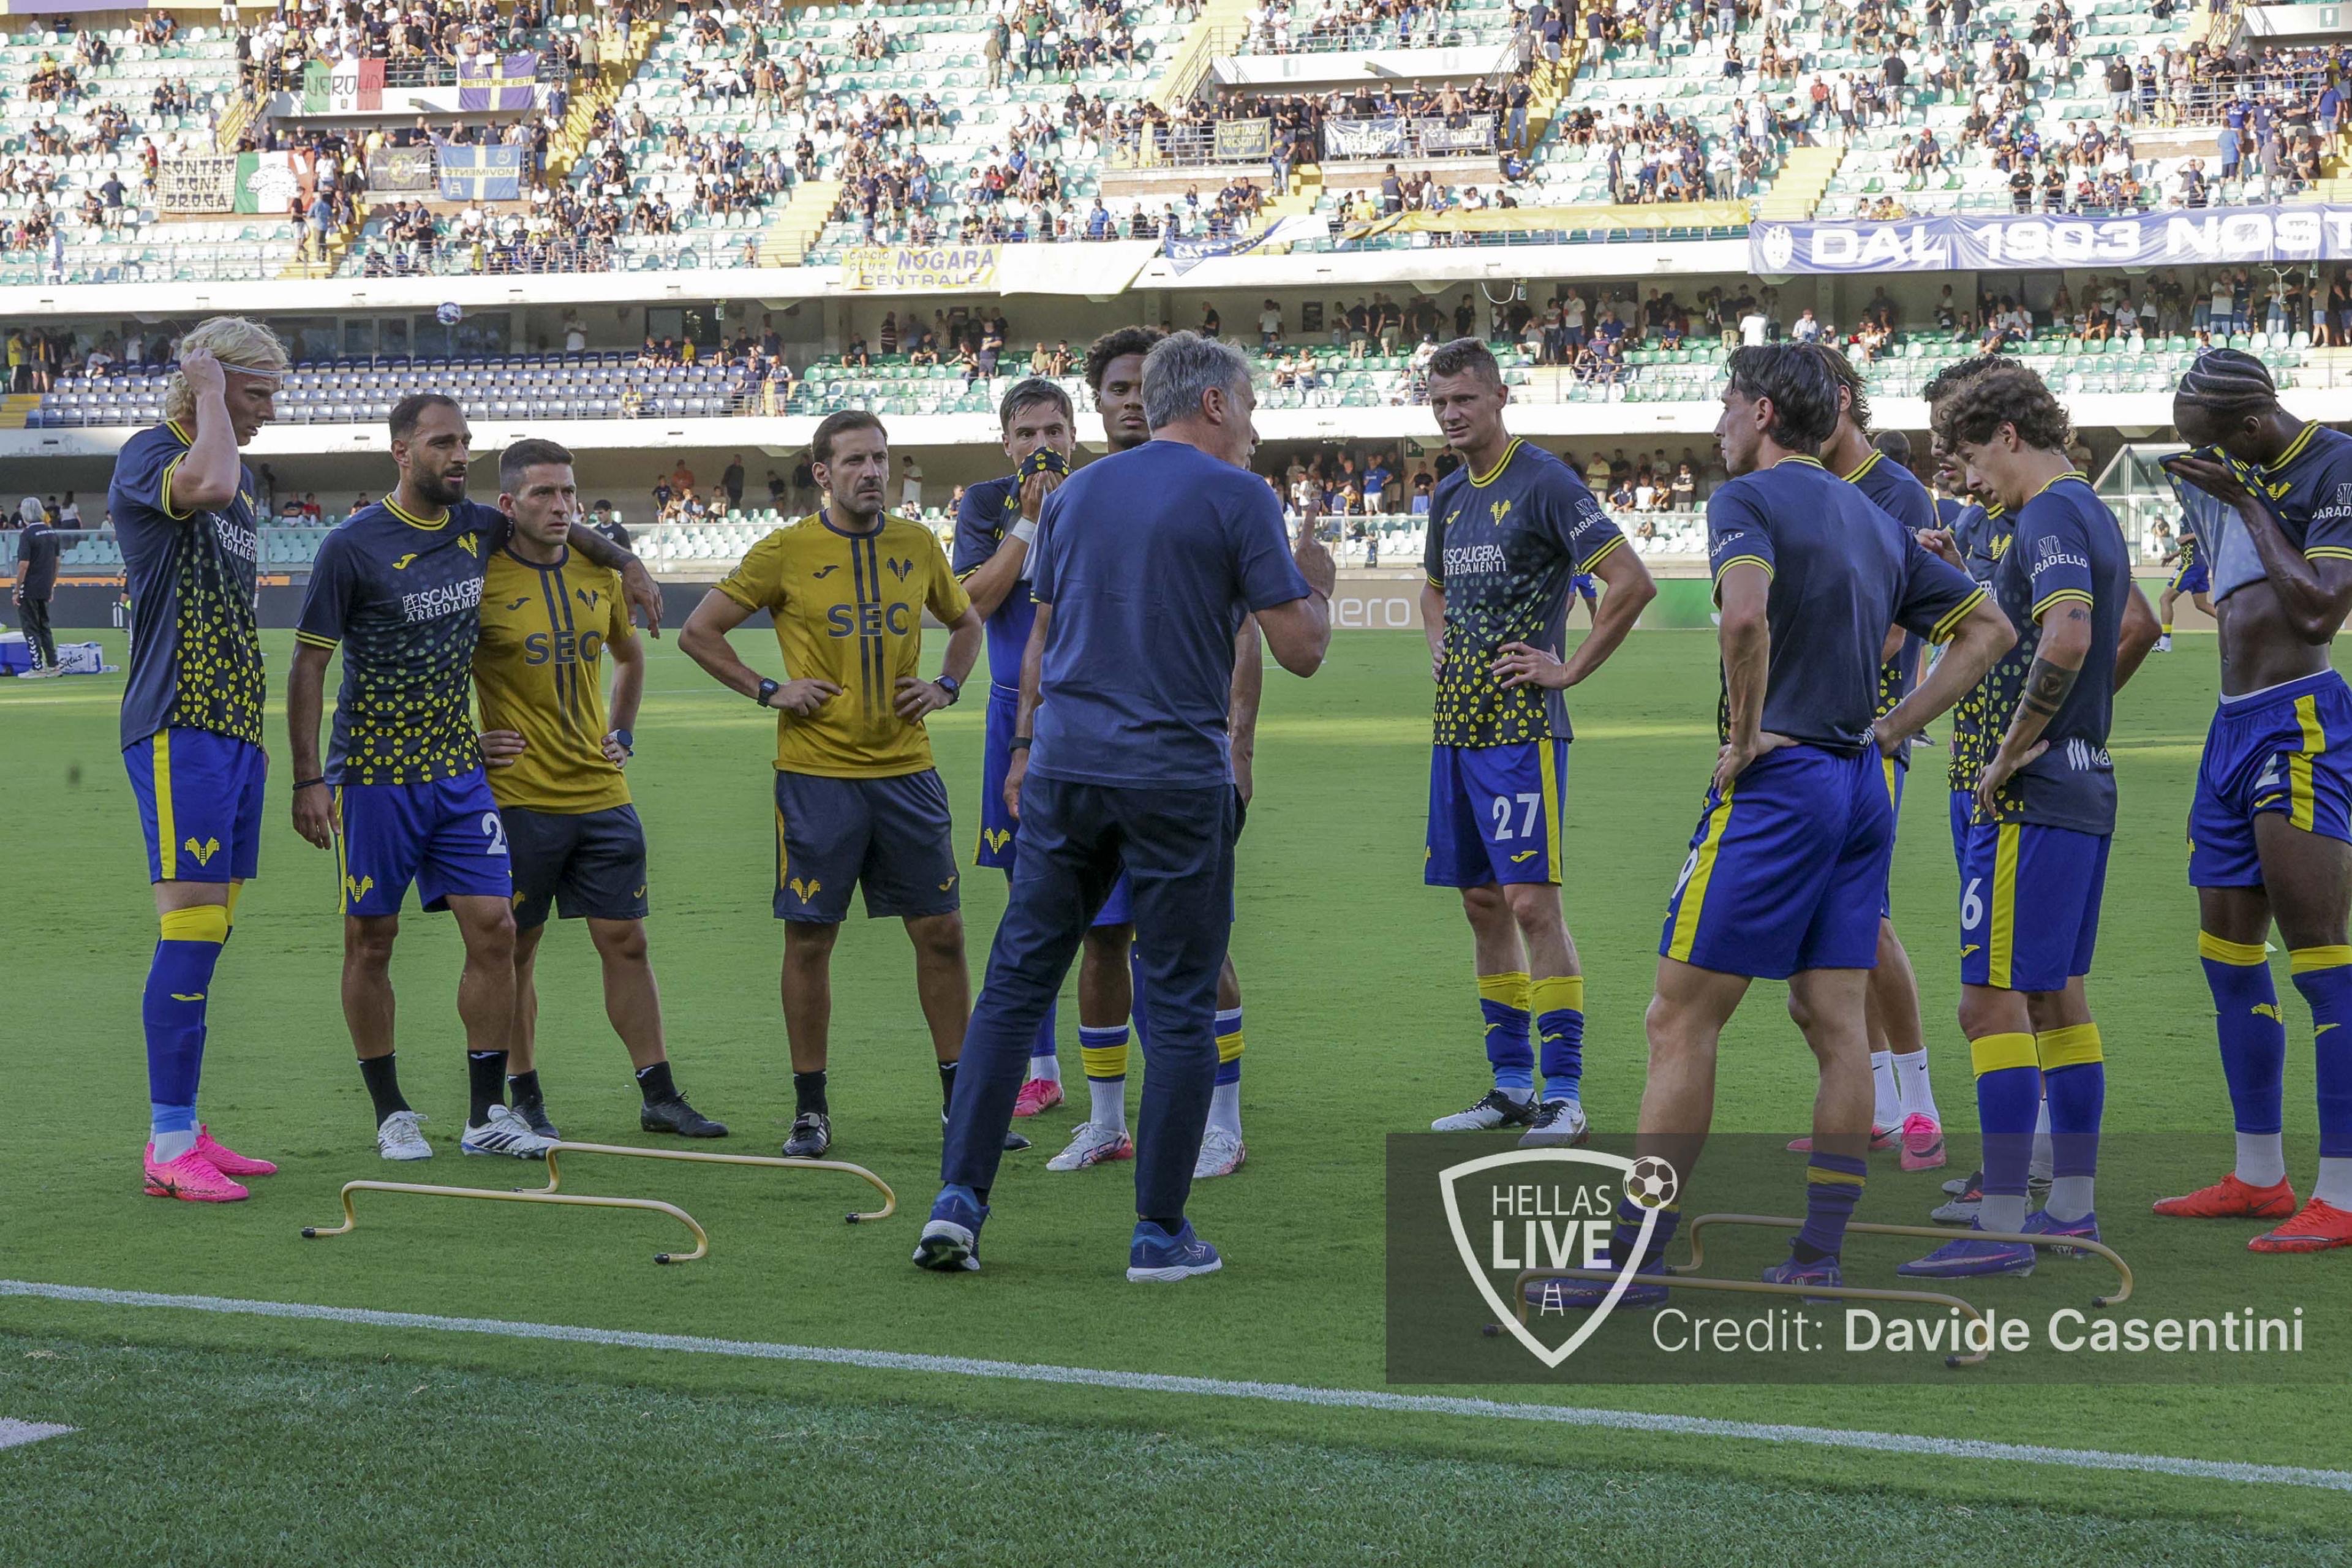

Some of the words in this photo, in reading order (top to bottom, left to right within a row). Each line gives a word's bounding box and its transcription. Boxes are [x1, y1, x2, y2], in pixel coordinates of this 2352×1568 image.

[461, 78, 507, 87] SETTORE
[162, 159, 235, 175] CONTRO
[166, 194, 227, 208] DROGA
[1812, 224, 1947, 264] DAL
[1973, 221, 2141, 260] 1903
[849, 251, 889, 260] CALCIO
[897, 249, 993, 271] NOGARA
[849, 263, 886, 271] CLUB
[861, 273, 980, 285] CENTRALE
[1448, 544, 1506, 565] SCALIGERA
[827, 602, 910, 638] SEC
[524, 630, 601, 666] SEC
[1492, 793, 1541, 841] 27
[481, 812, 507, 854] 2
[1961, 878, 1983, 930] 6
